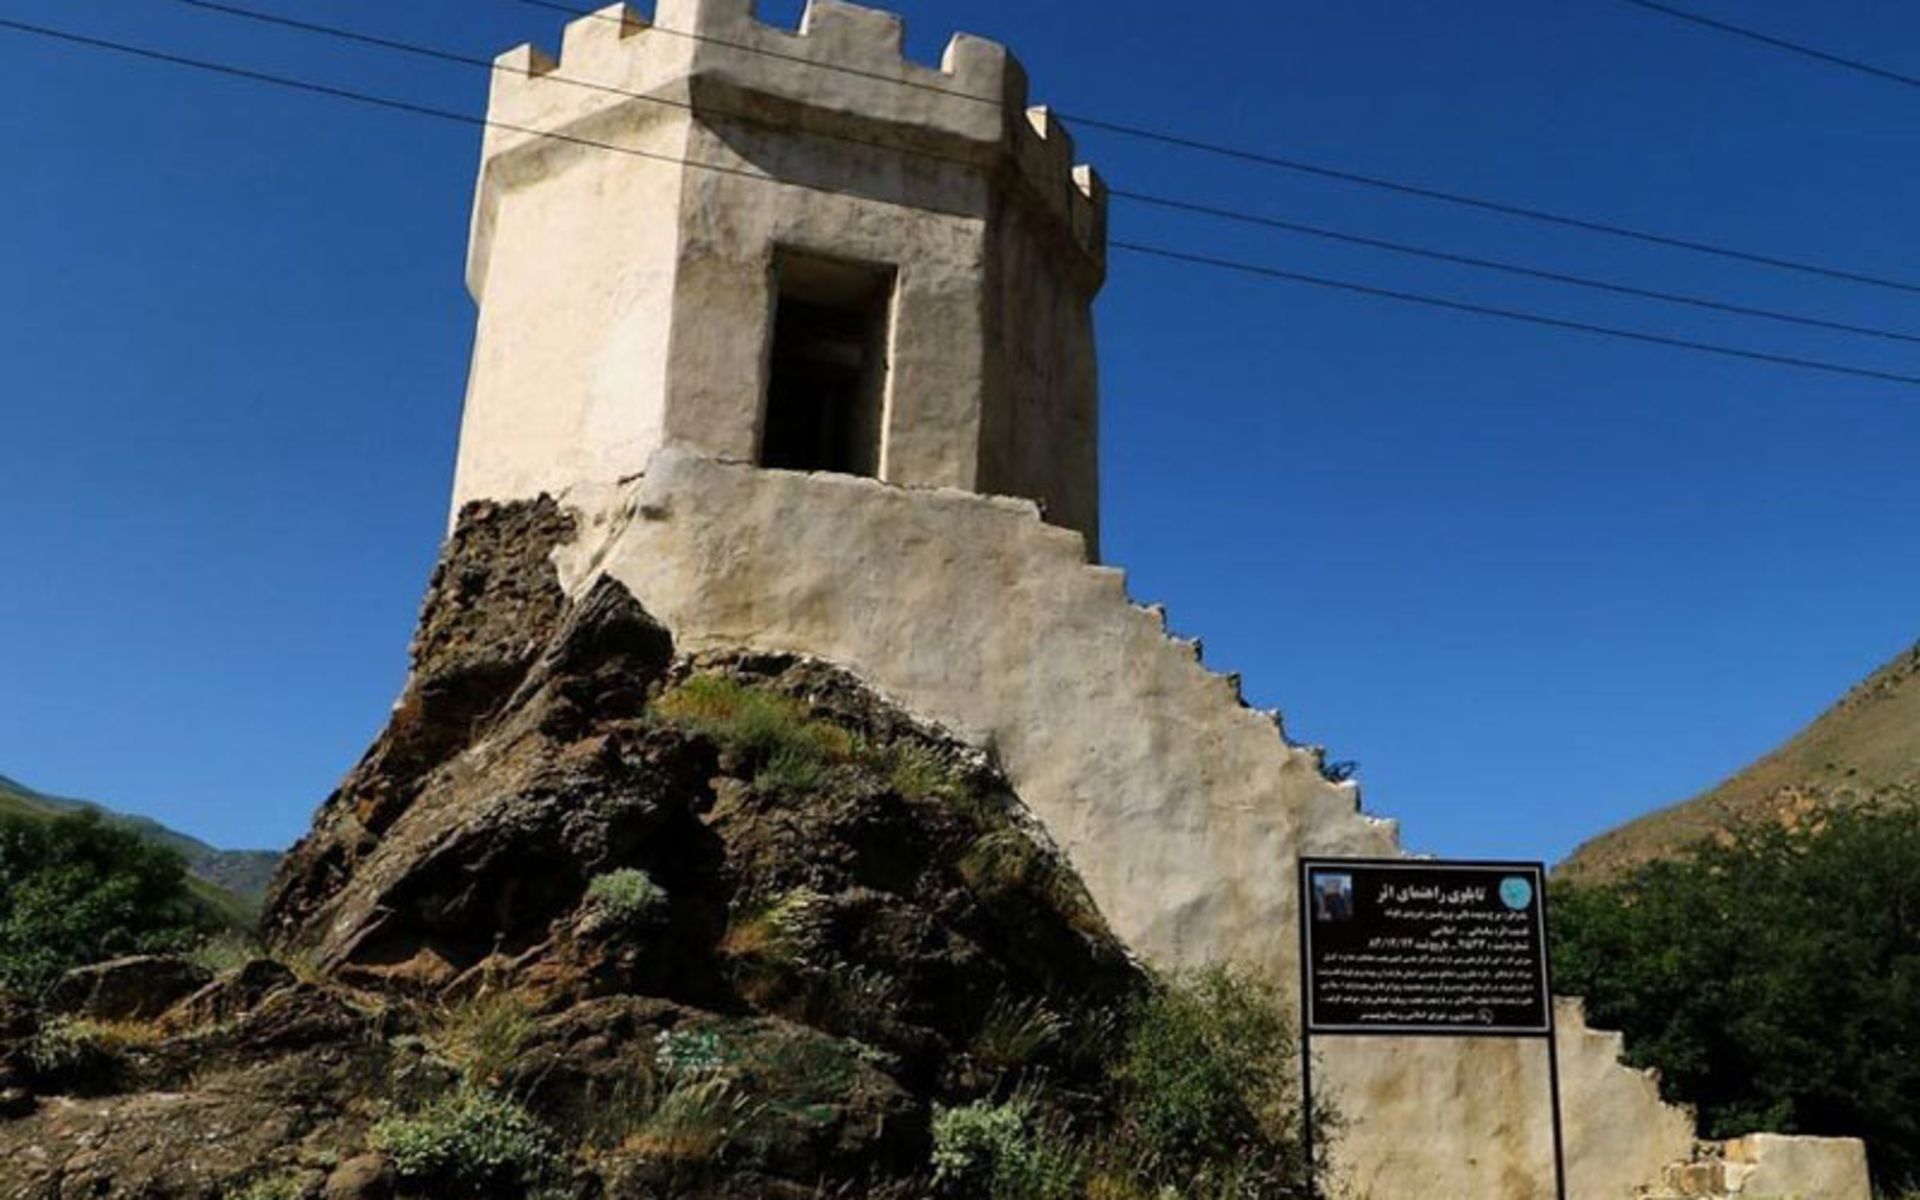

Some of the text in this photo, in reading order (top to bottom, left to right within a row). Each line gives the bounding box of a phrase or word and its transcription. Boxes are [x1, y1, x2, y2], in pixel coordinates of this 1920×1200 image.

[1376, 882, 1487, 905] تابلوی راهنمای اثر
